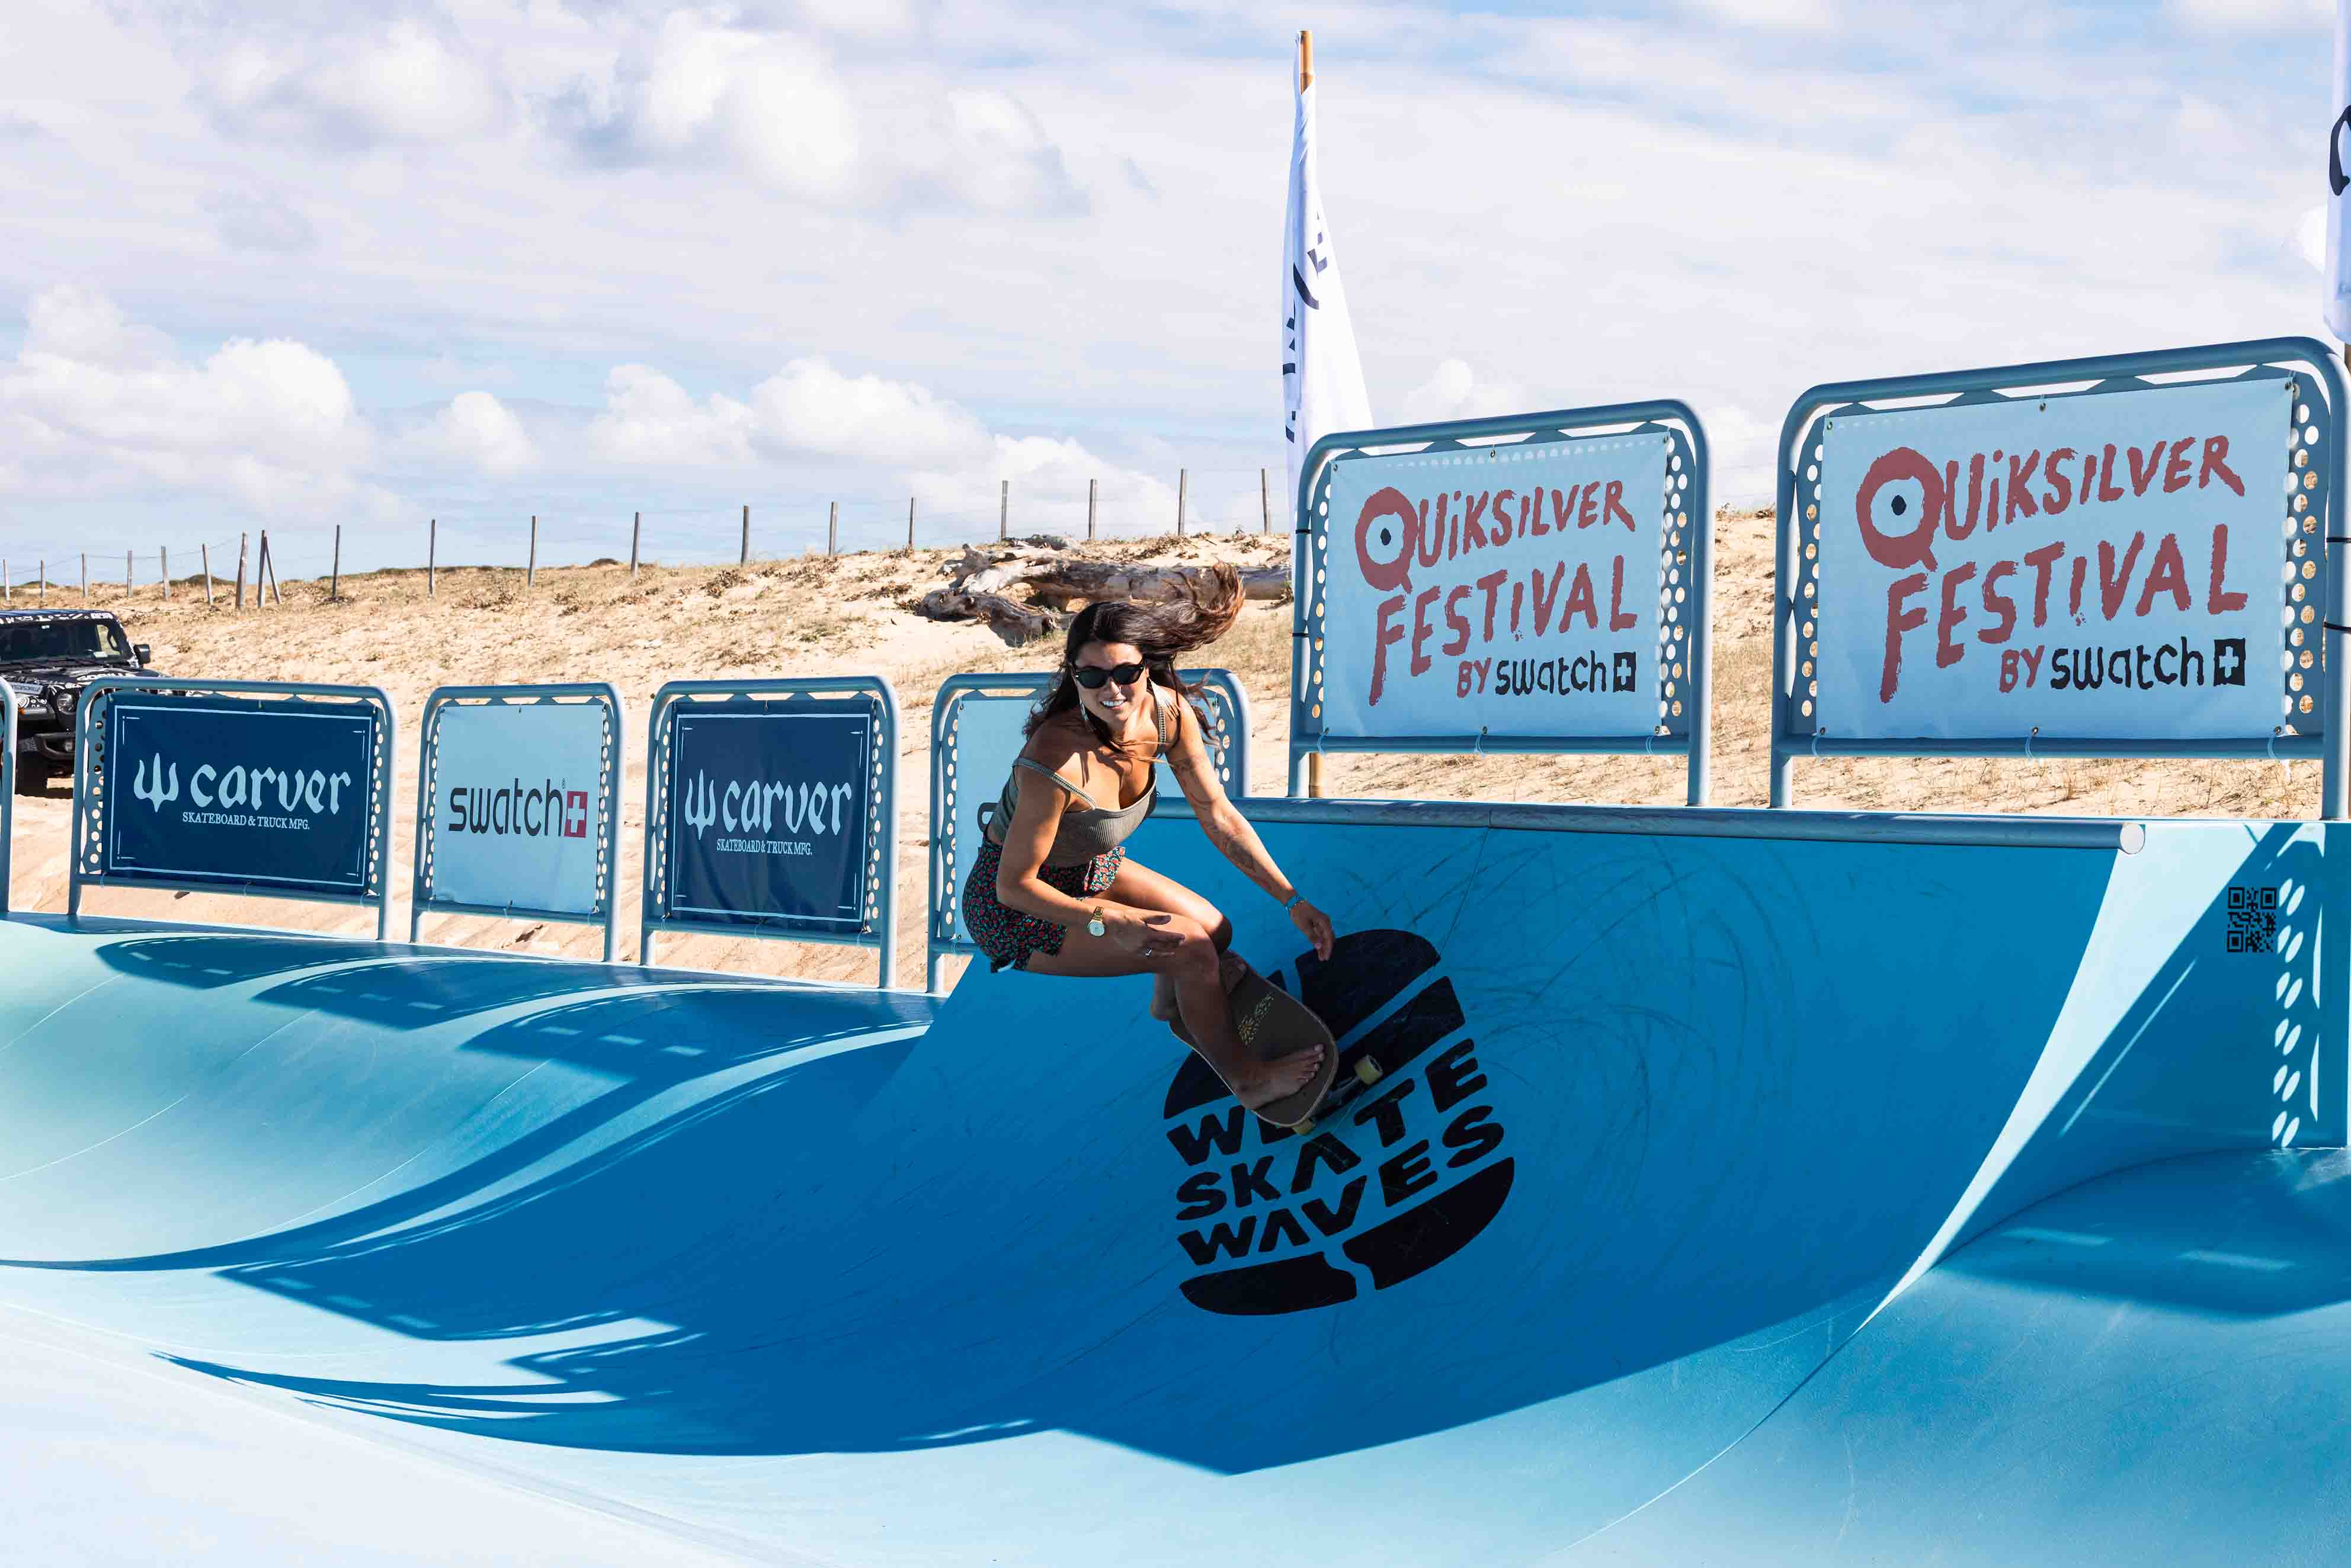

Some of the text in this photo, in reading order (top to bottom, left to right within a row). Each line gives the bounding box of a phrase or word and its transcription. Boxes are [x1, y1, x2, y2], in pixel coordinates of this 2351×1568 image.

[1369, 555, 1638, 707] FESTIVAL
[1881, 524, 2248, 704] FESTIVAL
[1456, 650, 1607, 698] BY swatch
[1998, 636, 2205, 694] BY swatch
[190, 764, 351, 815] carver
[449, 778, 563, 836] swatch
[722, 780, 852, 836] carver
[182, 812, 310, 830] SKATEBOARD & TRUCK MFG.
[716, 838, 813, 855] SKATEBOARD & TRUCK MFG.
[1176, 1038, 1488, 1221] SKATE
[1177, 1105, 1504, 1266] WAVES
